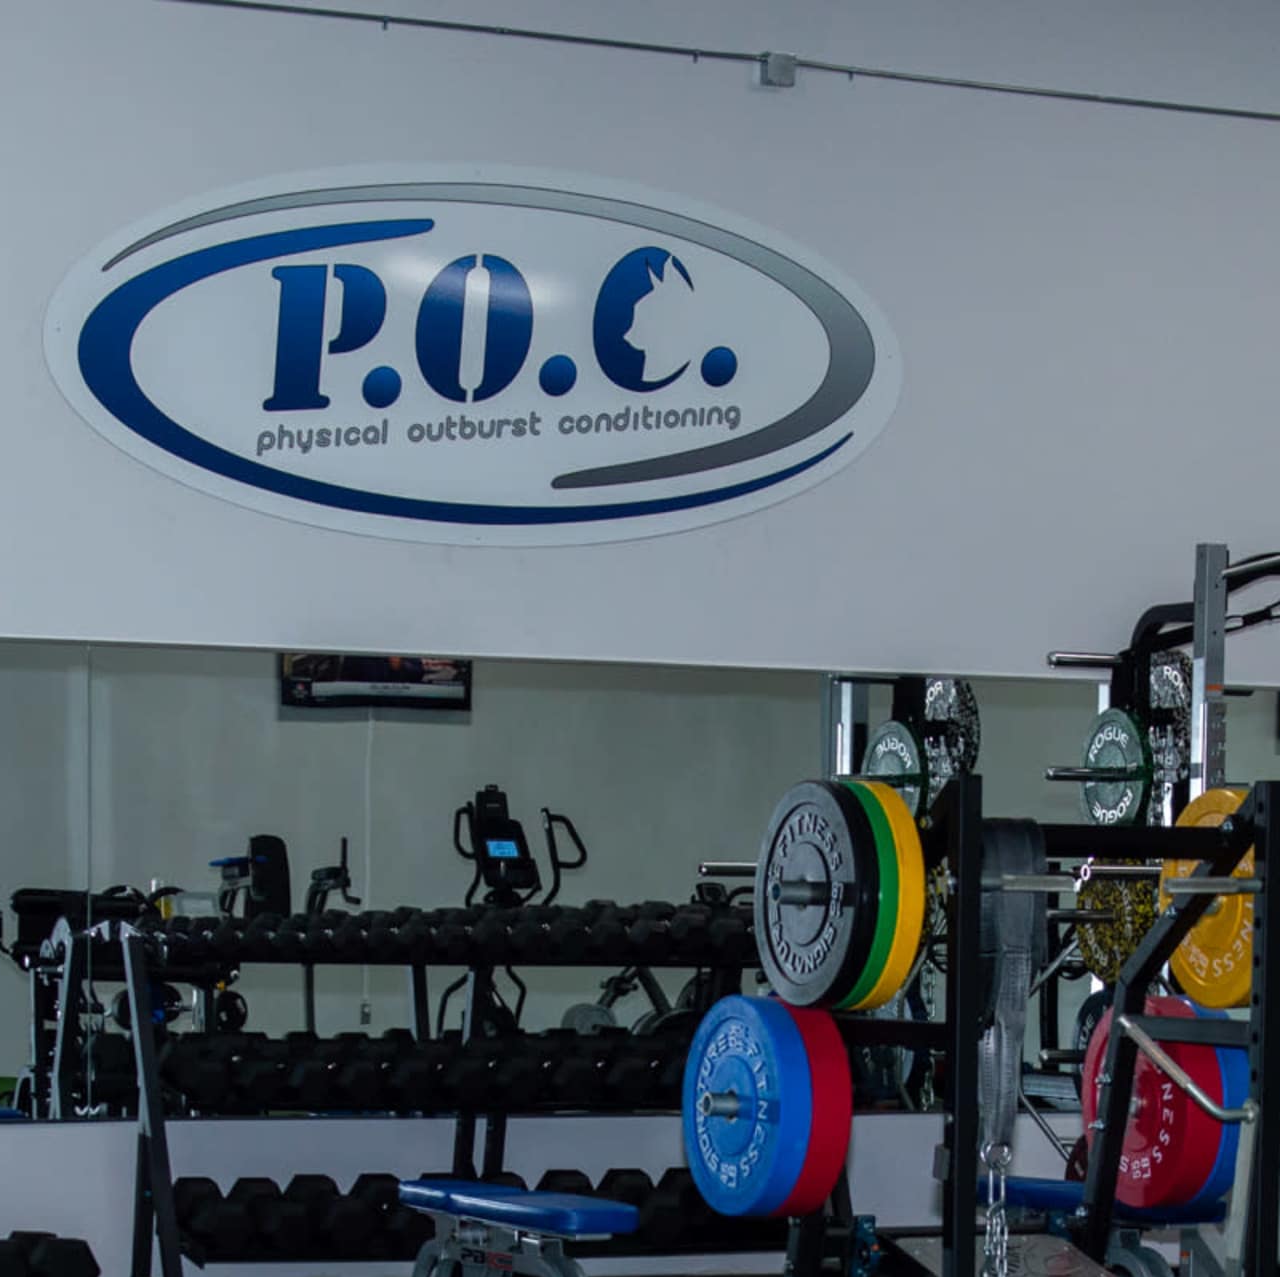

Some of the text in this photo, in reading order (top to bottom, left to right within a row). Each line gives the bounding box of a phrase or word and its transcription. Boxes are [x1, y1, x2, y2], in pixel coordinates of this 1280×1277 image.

[262, 245, 739, 413] P.O.C.
[256, 403, 742, 456] physical outburst conditioning
[1088, 725, 1131, 762] ROGUE
[1092, 788, 1134, 824] ROGUE
[777, 812, 843, 872] FITNESS
[739, 1042, 769, 1177] FITNESS
